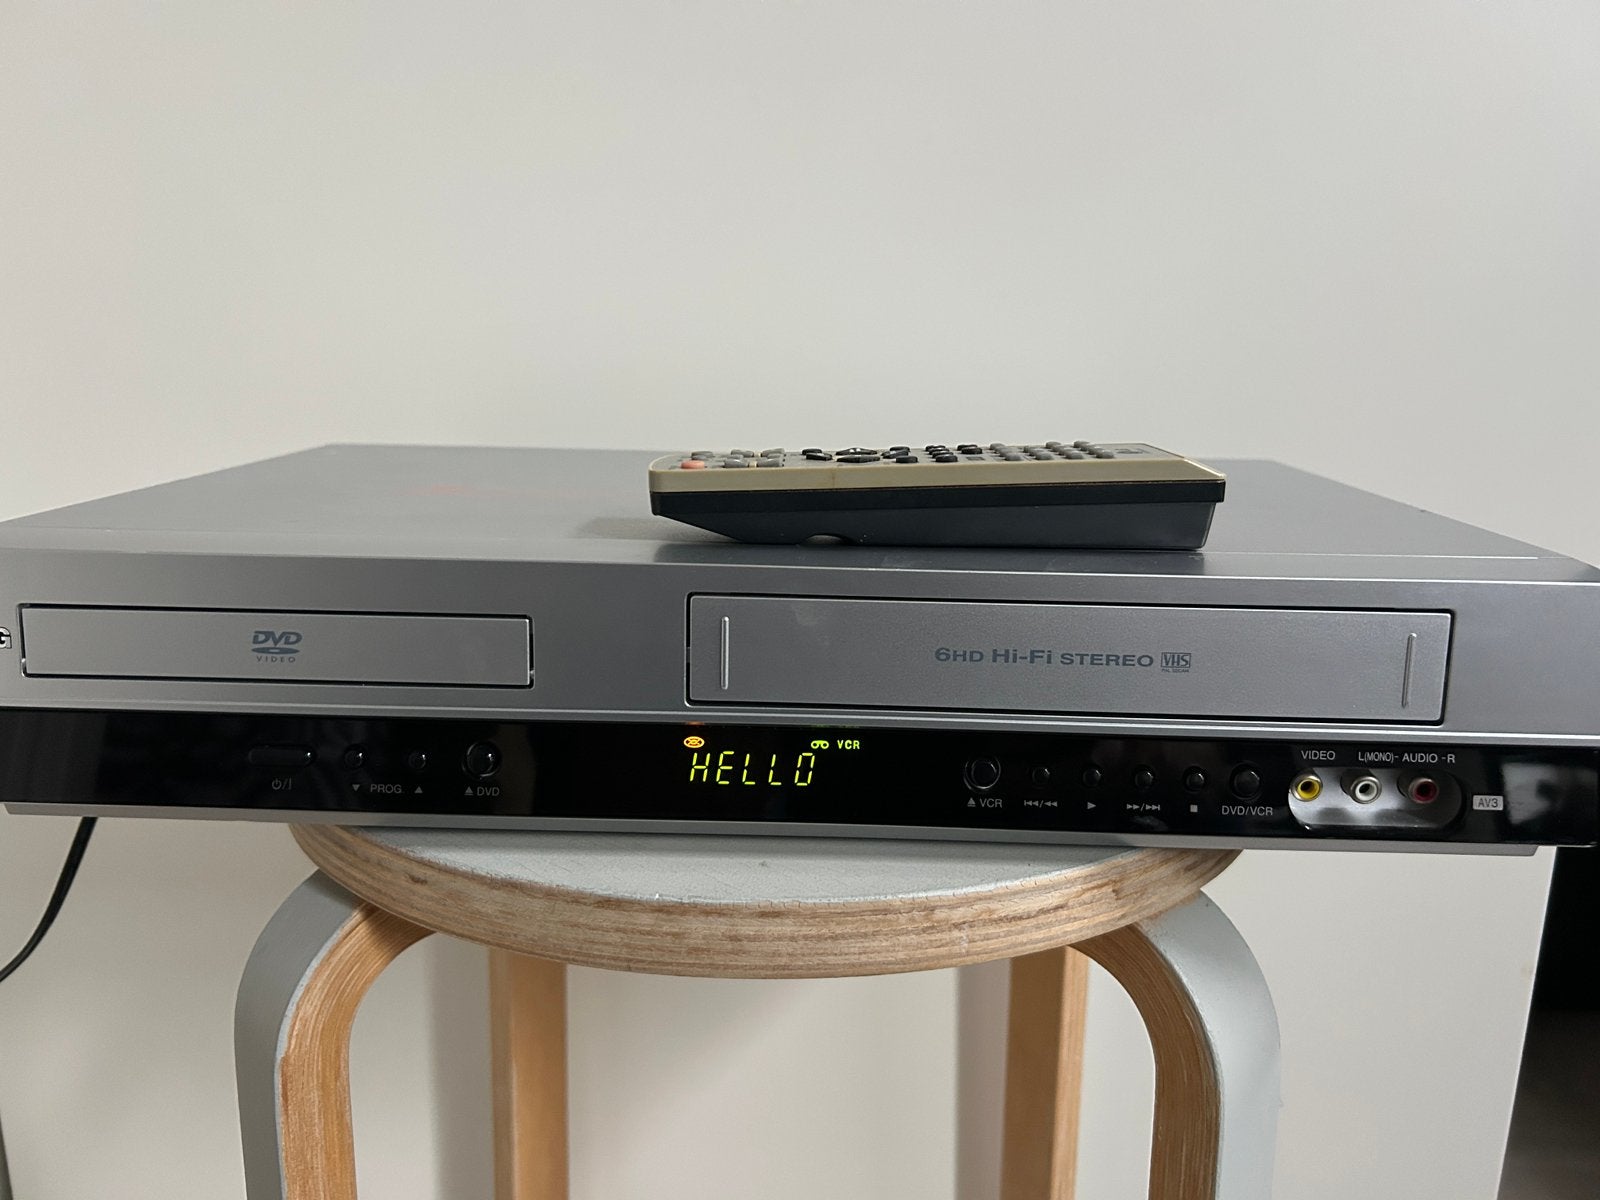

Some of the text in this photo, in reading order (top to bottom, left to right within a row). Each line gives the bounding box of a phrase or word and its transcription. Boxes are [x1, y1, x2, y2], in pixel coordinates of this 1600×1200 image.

[252, 631, 303, 647] DVD
[256, 655, 296, 663] VIDEO
[934, 647, 1154, 668] 6HD Hi-Fi STEREO
[1163, 654, 1189, 667] VHS
[837, 739, 860, 750] VCR
[1300, 750, 1336, 761] VIDEO
[1402, 752, 1438, 763] AUDIO
[689, 751, 815, 786] HELLO
[476, 786, 500, 797] DVD
[979, 798, 1003, 808] VCR
[1477, 797, 1499, 808] AV3
[1221, 805, 1274, 817] DVD/VCR
